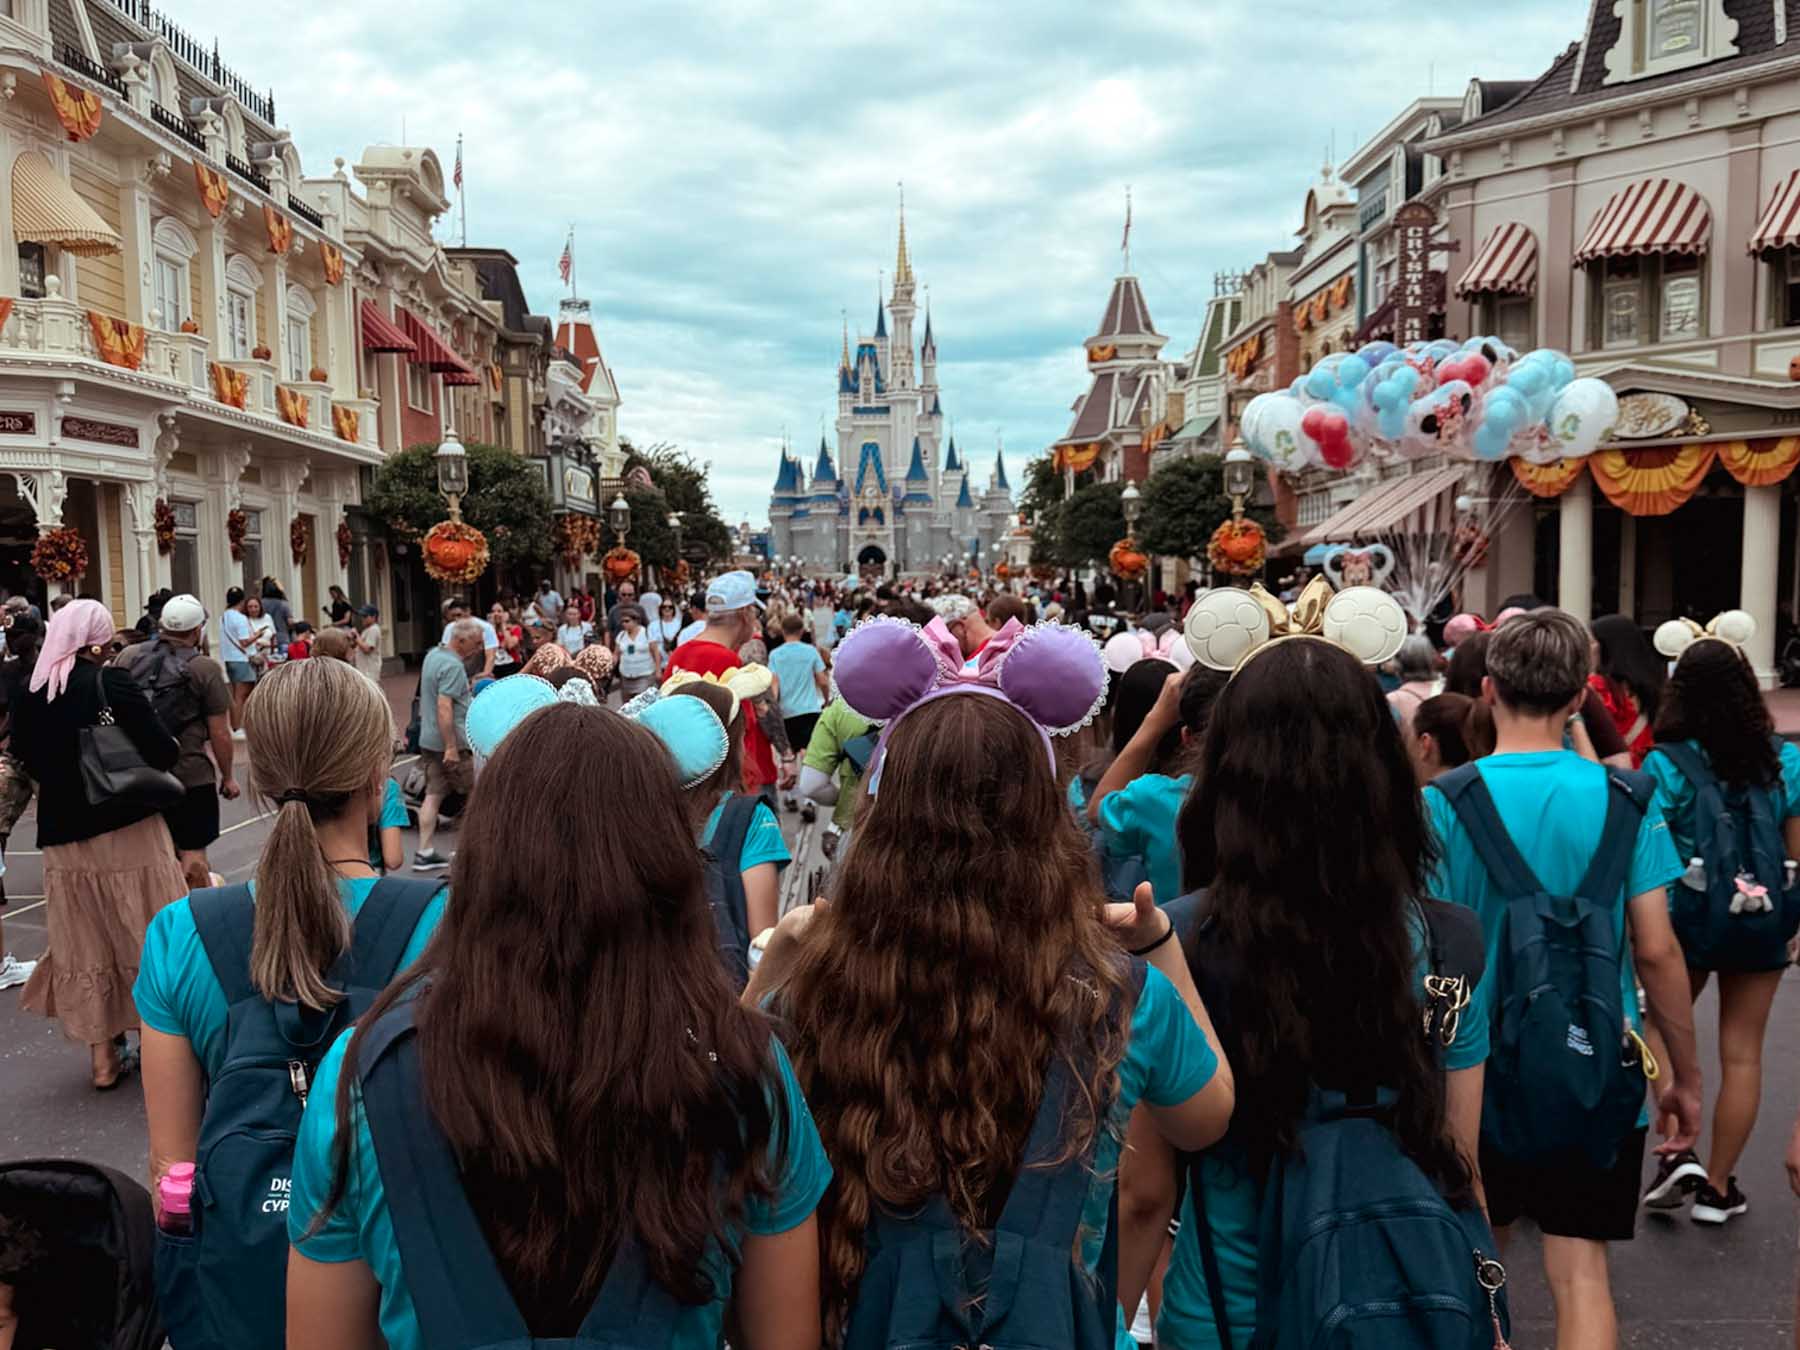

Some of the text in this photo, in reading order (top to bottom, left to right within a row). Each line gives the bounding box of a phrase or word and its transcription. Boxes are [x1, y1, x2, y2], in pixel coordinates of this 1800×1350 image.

[1404, 226, 1423, 345] CRYSTAL AR
[262, 1200, 290, 1213] CYP
